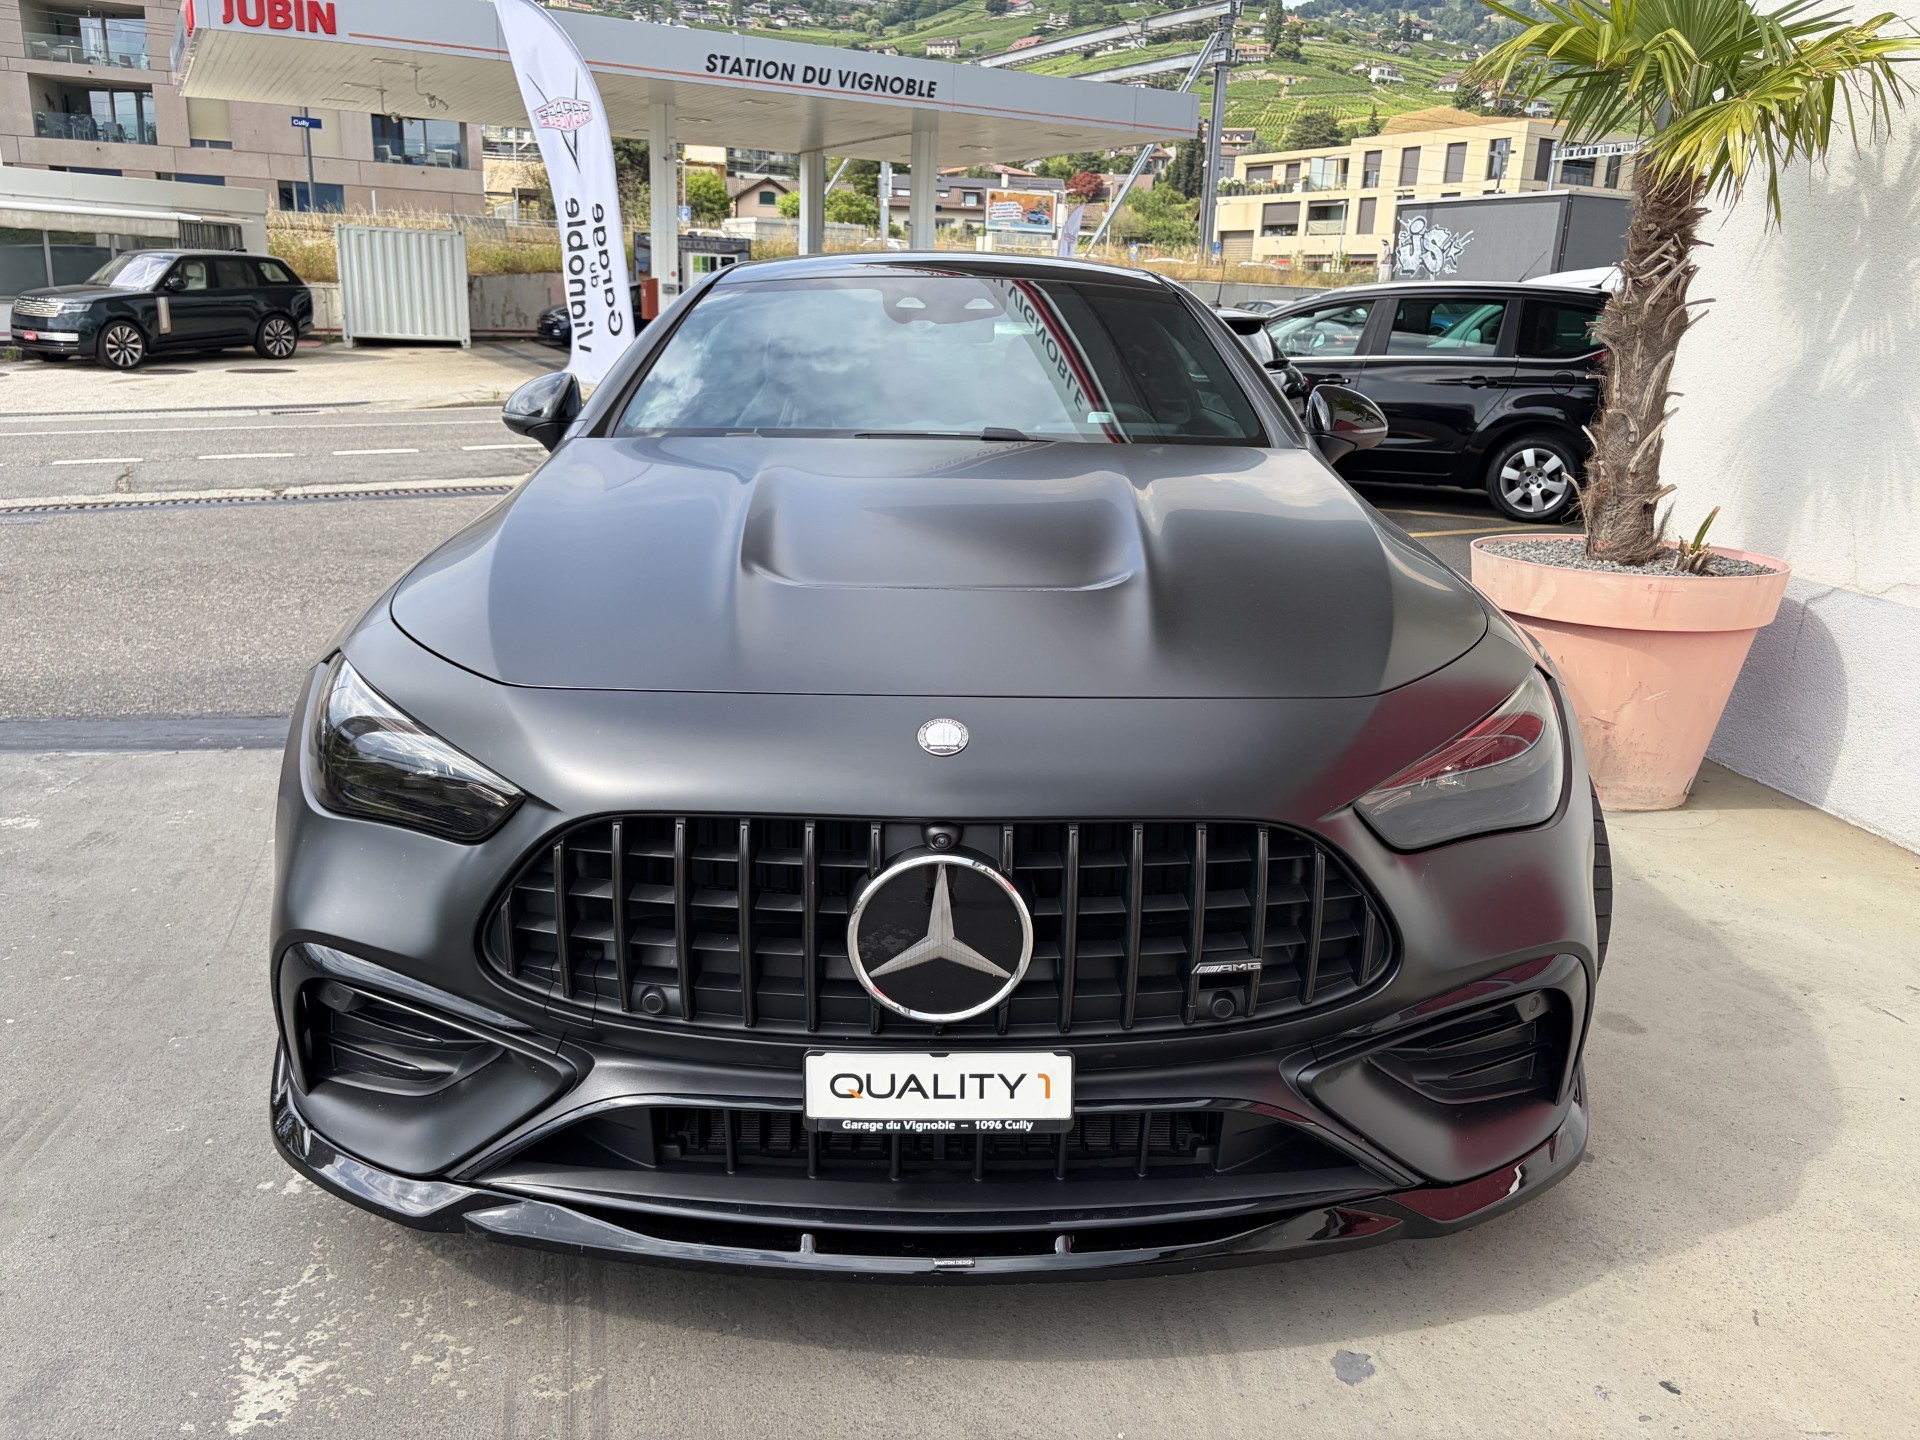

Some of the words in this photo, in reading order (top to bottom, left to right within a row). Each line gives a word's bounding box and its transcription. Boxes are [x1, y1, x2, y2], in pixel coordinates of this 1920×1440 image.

[222, 0, 337, 35] JUBIN
[705, 53, 796, 82] STATION
[802, 65, 832, 86] DU
[838, 69, 938, 99] VIGNOBLE
[293, 119, 310, 128] Cully
[829, 1073, 1028, 1100] QUALITY
[1037, 1073, 1051, 1100] 1
[842, 1120, 883, 1132] Garage
[885, 1120, 900, 1130] du
[903, 1120, 956, 1132] Vignoble
[974, 1120, 1002, 1130] 1096
[1005, 1120, 1034, 1132] Cully
